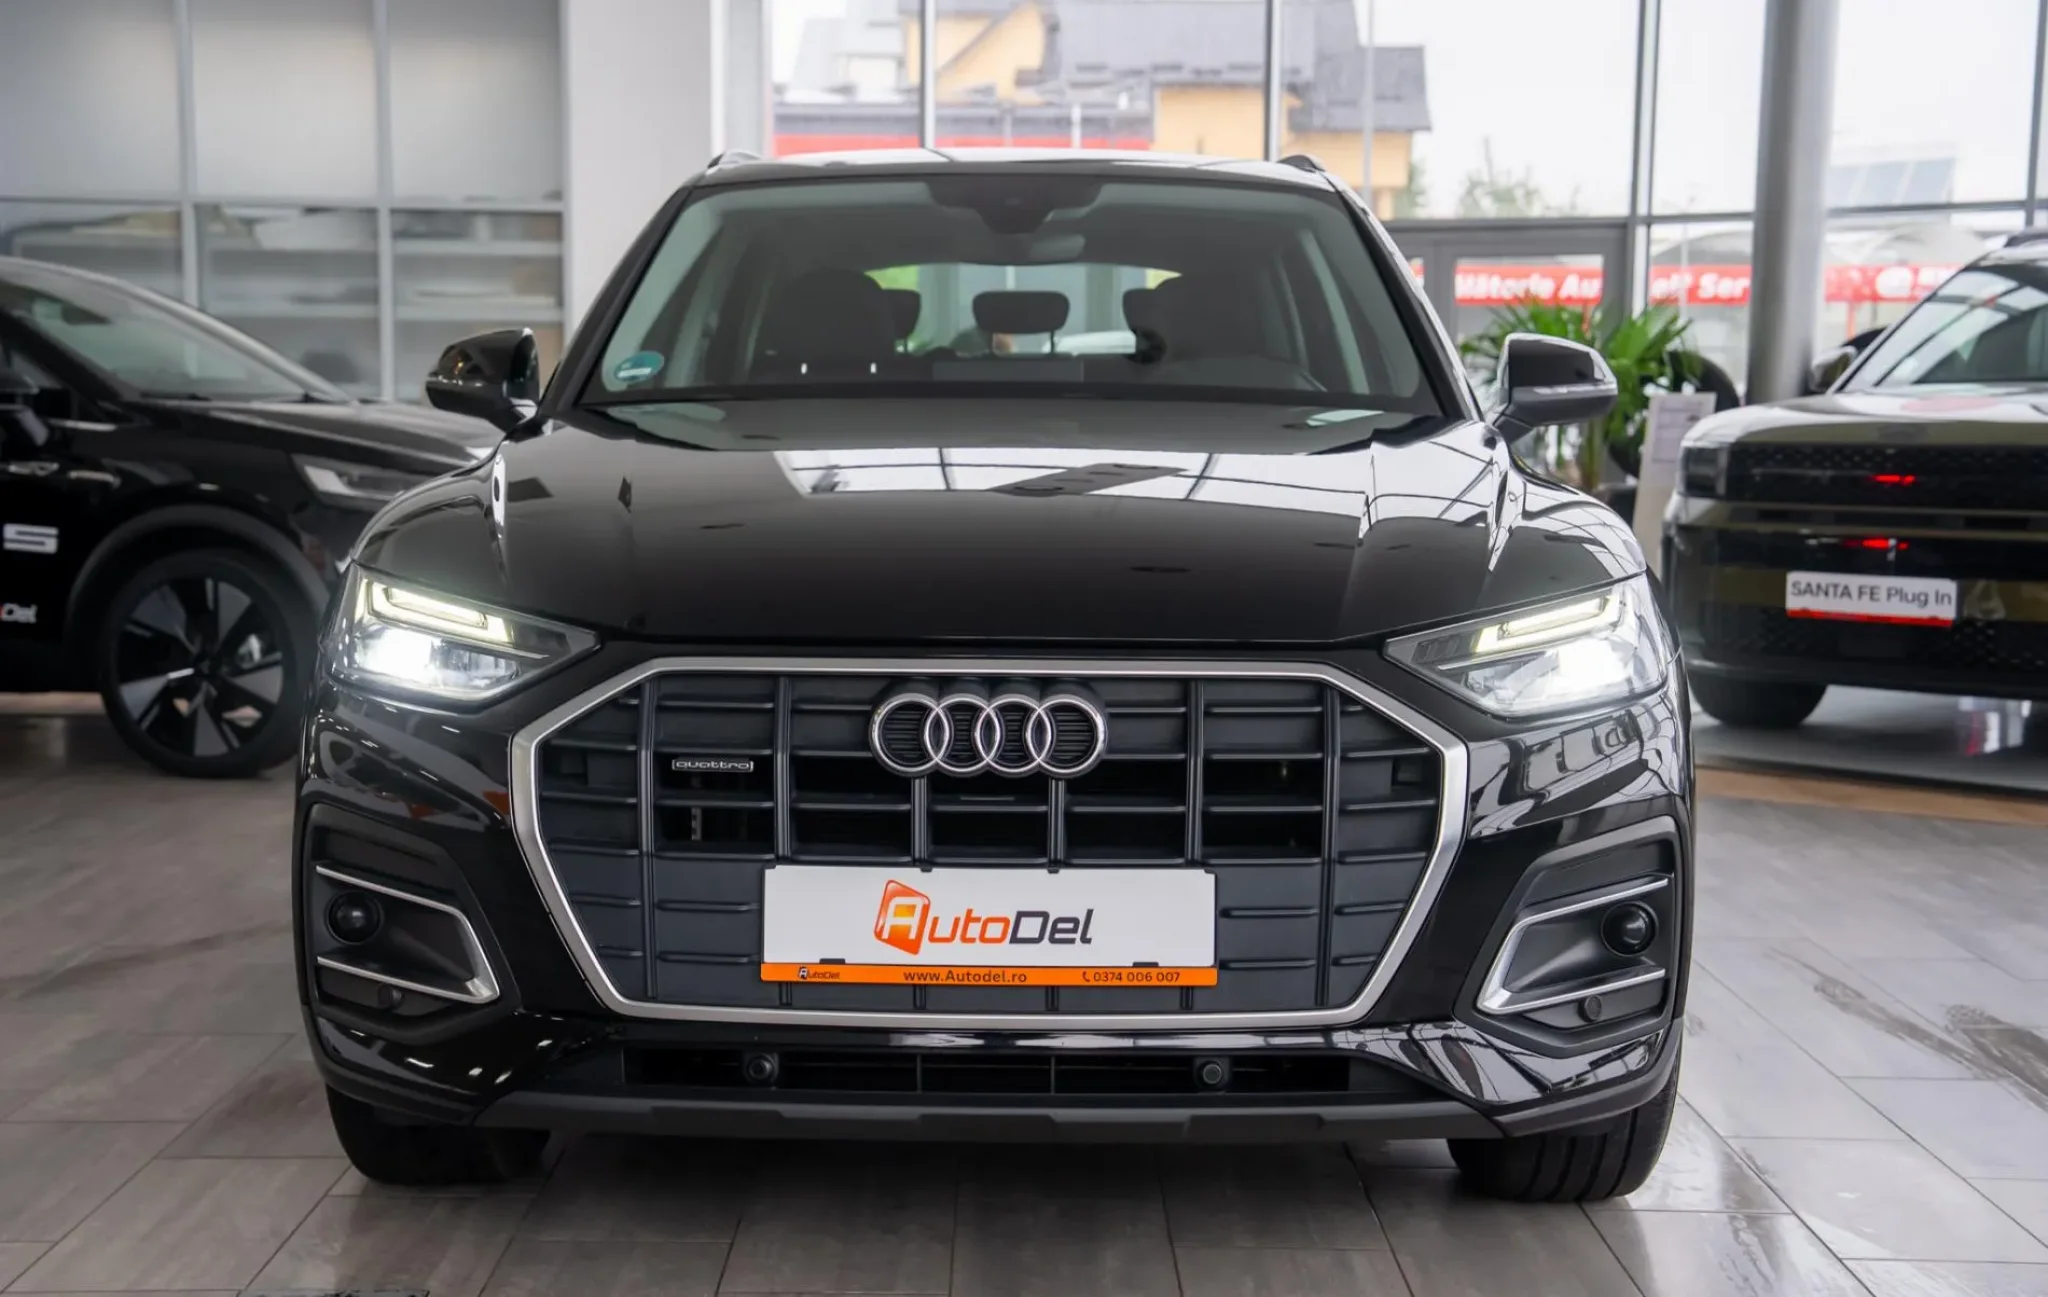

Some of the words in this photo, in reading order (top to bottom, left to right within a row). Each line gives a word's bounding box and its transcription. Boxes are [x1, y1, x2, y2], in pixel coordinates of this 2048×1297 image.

[1791, 580, 1853, 601] SANTA
[1857, 584, 1881, 602] FE
[1886, 586, 1929, 608] Plug
[1934, 588, 1952, 606] In
[676, 760, 750, 770] quattro
[880, 895, 1094, 946] AutoDel
[903, 970, 1027, 983] www.Autodel.ro
[1093, 971, 1122, 982] 0374
[1126, 971, 1153, 982] 006
[1156, 971, 1180, 982] 007
